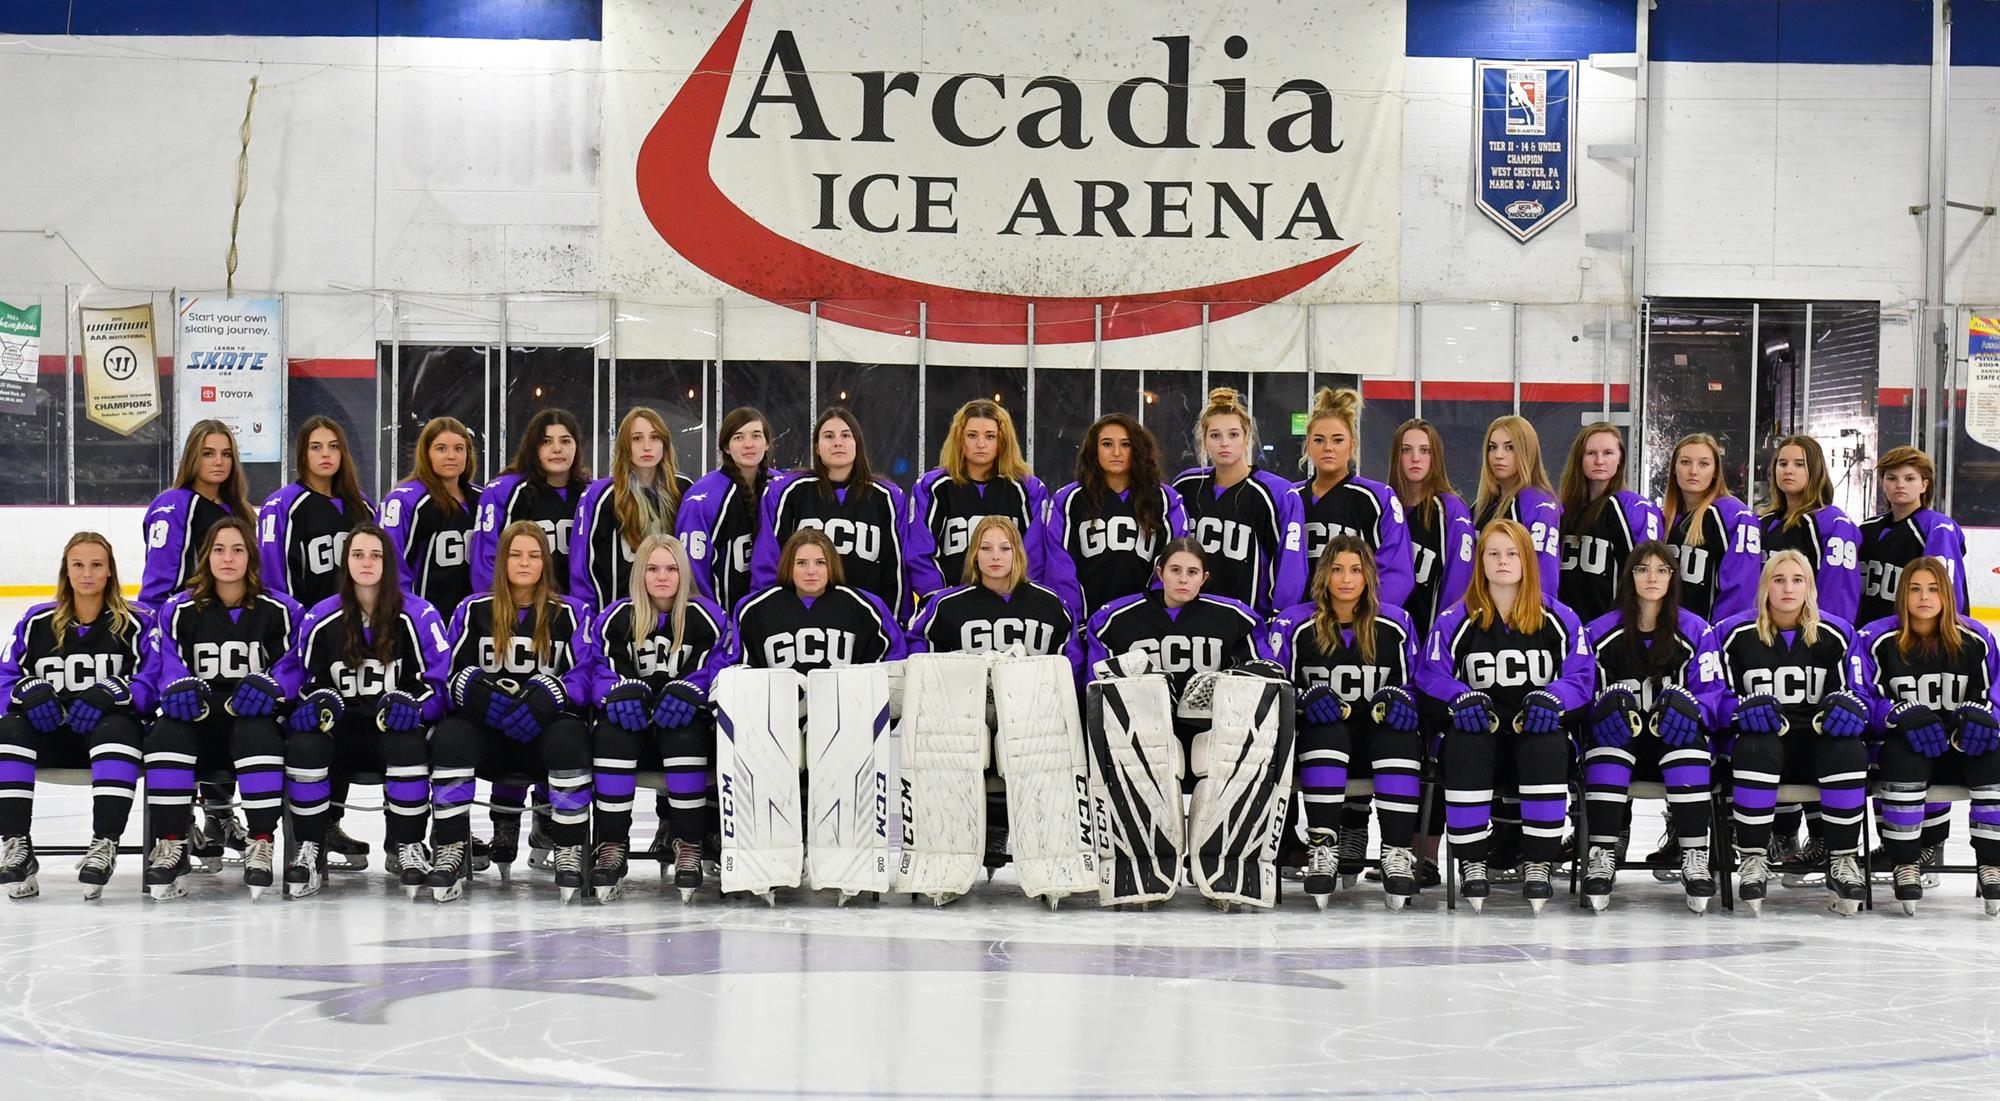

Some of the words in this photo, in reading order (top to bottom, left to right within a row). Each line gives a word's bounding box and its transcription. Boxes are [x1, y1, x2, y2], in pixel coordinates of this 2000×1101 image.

[727, 30, 1344, 153] Arcadia
[1489, 141, 1506, 151] TIER
[1521, 142, 1529, 151] 14
[1537, 142, 1561, 152] UNDER
[1507, 154, 1543, 164] CHAMPION
[1489, 179, 1514, 189] MARCH
[1516, 180, 1525, 189] 30
[1531, 180, 1553, 190] APRIL
[1555, 180, 1560, 189] 3
[1491, 167, 1511, 177] WEST
[1513, 167, 1546, 178] CHESTER,
[1548, 168, 1559, 177] PA
[811, 174, 958, 234] ICE
[997, 177, 1344, 241] ARENA
[86, 321, 149, 332] WARRIOR
[185, 325, 224, 335] skating
[226, 326, 270, 336] journey.
[188, 312, 214, 321] Start
[217, 314, 242, 323] your
[244, 315, 267, 323] own
[186, 351, 269, 370] SKATE
[94, 400, 152, 411] CHAMPIONS
[1189, 516, 1252, 561] CU
[1459, 533, 1473, 562] 6
[1530, 521, 1560, 557] 22
[1735, 524, 1761, 554] 15
[1826, 537, 1857, 571] 39
[478, 636, 564, 675] GCU
[763, 627, 855, 669] GCU
[960, 617, 1054, 656] GCU
[35, 653, 124, 693] GCU
[1465, 649, 1554, 690] GCU
[1742, 666, 1828, 704] GCU
[1889, 672, 1969, 711] GCU
[722, 773, 735, 839] CCM
[875, 771, 887, 838] CCM
[900, 777, 914, 847] CCM
[1075, 774, 1092, 846] CCM
[1094, 796, 1110, 850] CCM
[1268, 797, 1287, 852] CCM
